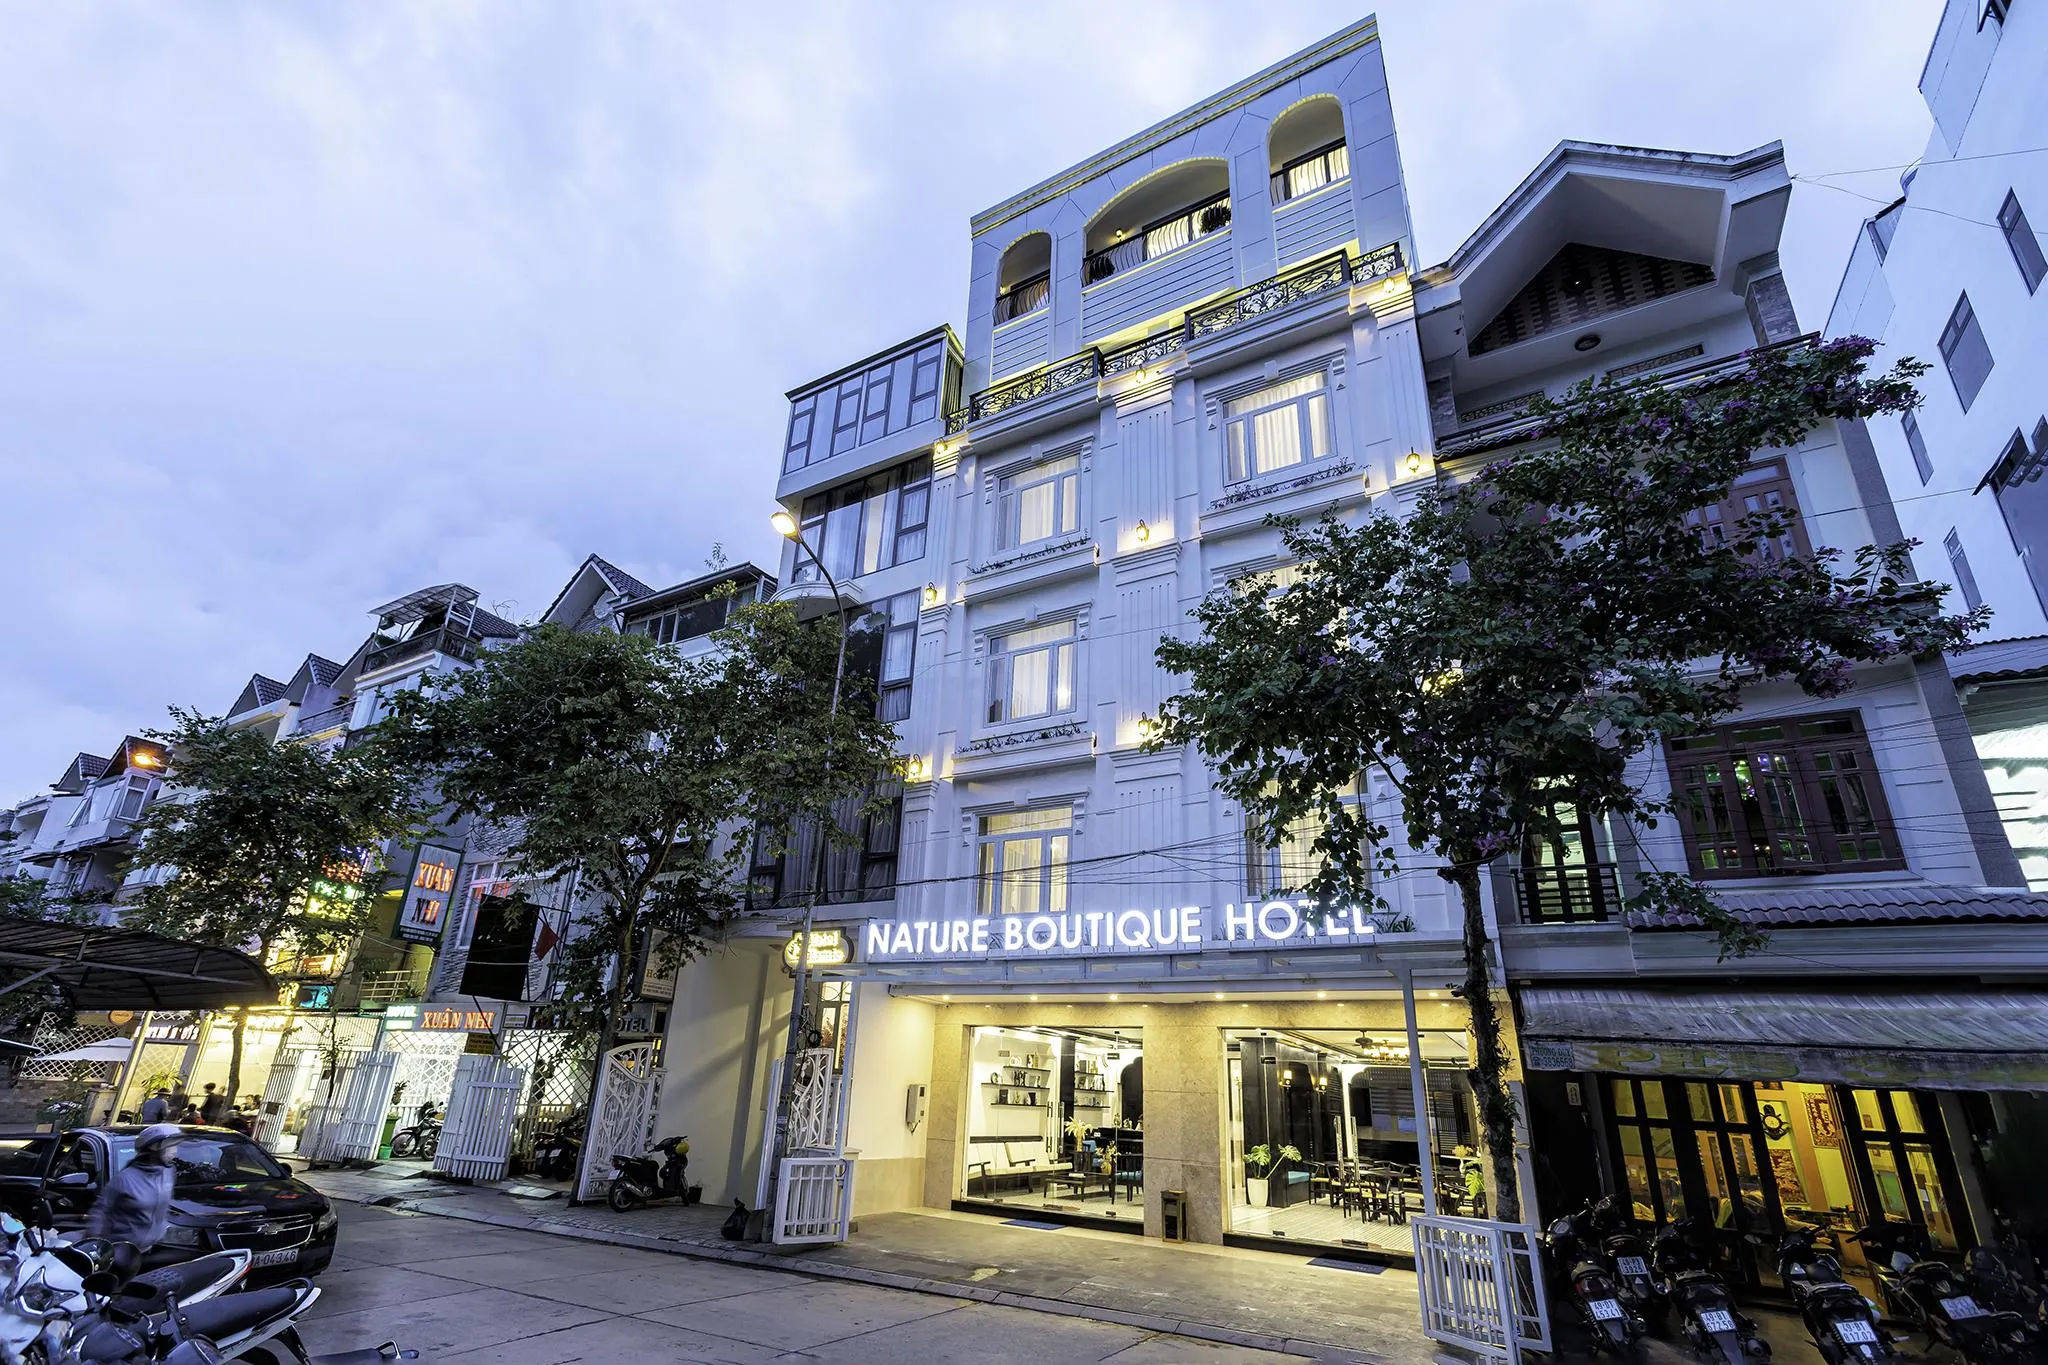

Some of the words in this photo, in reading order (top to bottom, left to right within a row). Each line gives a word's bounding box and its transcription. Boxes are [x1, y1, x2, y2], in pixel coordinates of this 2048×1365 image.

[413, 860, 454, 893] XUÂN
[411, 897, 441, 926] NHI
[868, 918, 990, 954] NATURE
[1004, 906, 1202, 950] BOUTIQUE
[1226, 898, 1375, 941] HOTEL
[421, 1007, 462, 1029] XUÂN
[464, 1012, 496, 1030] NHI
